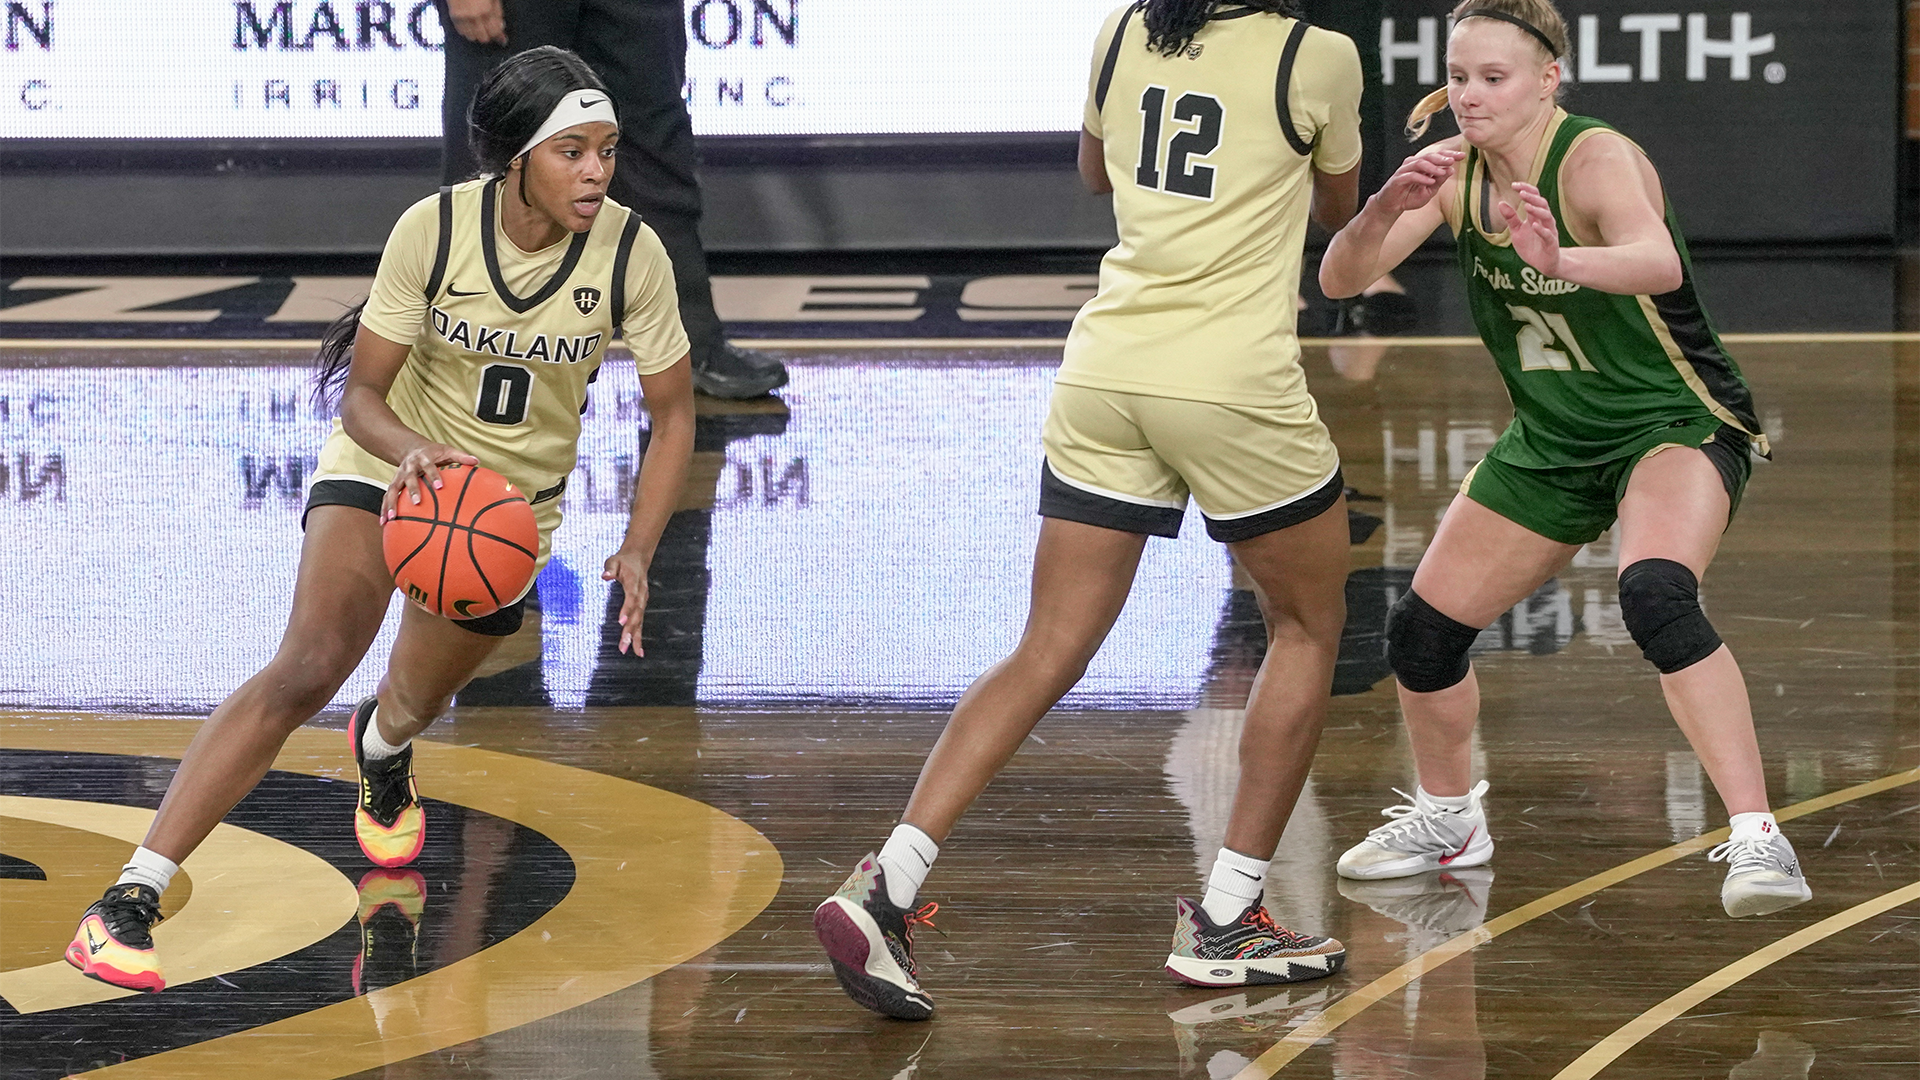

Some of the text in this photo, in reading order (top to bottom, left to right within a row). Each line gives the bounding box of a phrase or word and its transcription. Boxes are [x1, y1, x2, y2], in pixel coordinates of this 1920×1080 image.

[1380, 12, 1777, 84] HLTH
[233, 79, 420, 109] IRRIG
[1135, 83, 1226, 202] 12
[431, 305, 602, 364] OAKLAND
[1505, 303, 1599, 373] 21
[473, 361, 534, 426] 0
